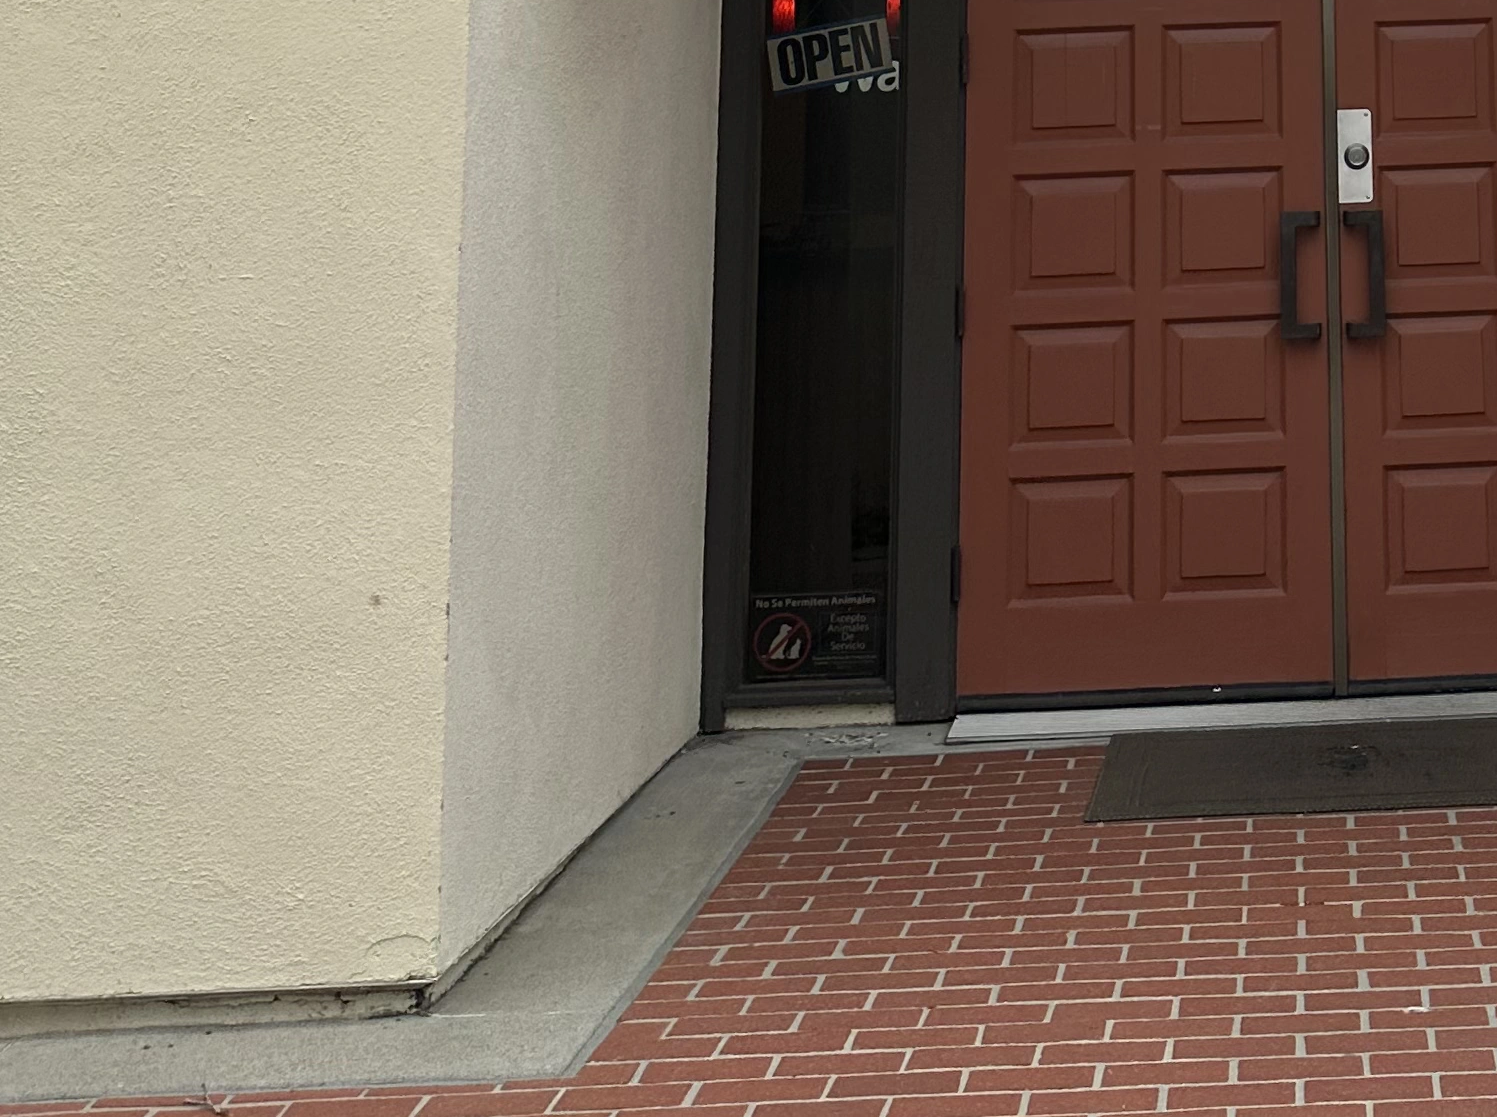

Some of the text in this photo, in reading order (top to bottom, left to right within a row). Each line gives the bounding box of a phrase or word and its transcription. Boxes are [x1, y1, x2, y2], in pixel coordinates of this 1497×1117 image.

[777, 22, 884, 86] OPEN
[755, 594, 876, 609] No Se Permiten Animales
[827, 623, 869, 632] Animales
[830, 641, 866, 651] Servicio
